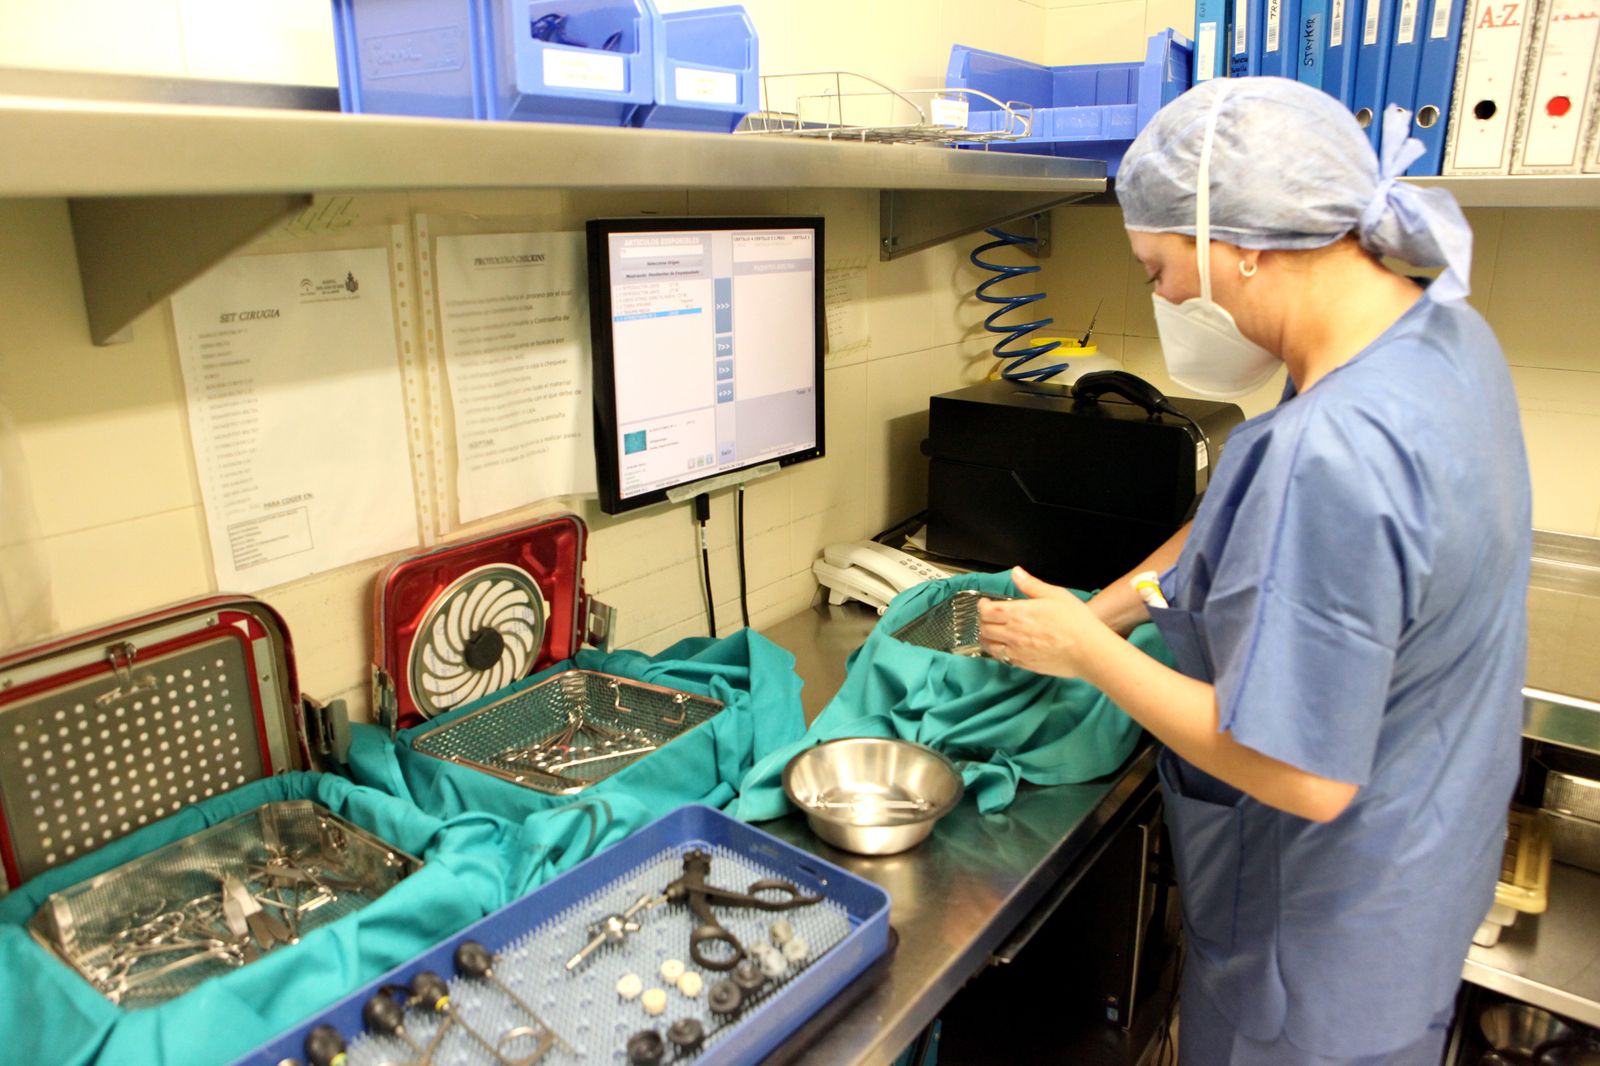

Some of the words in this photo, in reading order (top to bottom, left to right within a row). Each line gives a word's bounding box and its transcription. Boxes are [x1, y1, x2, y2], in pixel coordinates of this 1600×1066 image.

[1477, 4, 1520, 29] A-Z
[1303, 17, 1316, 67] STRYKER
[219, 312, 237, 324] SET
[239, 308, 280, 321] CIRUGIA
